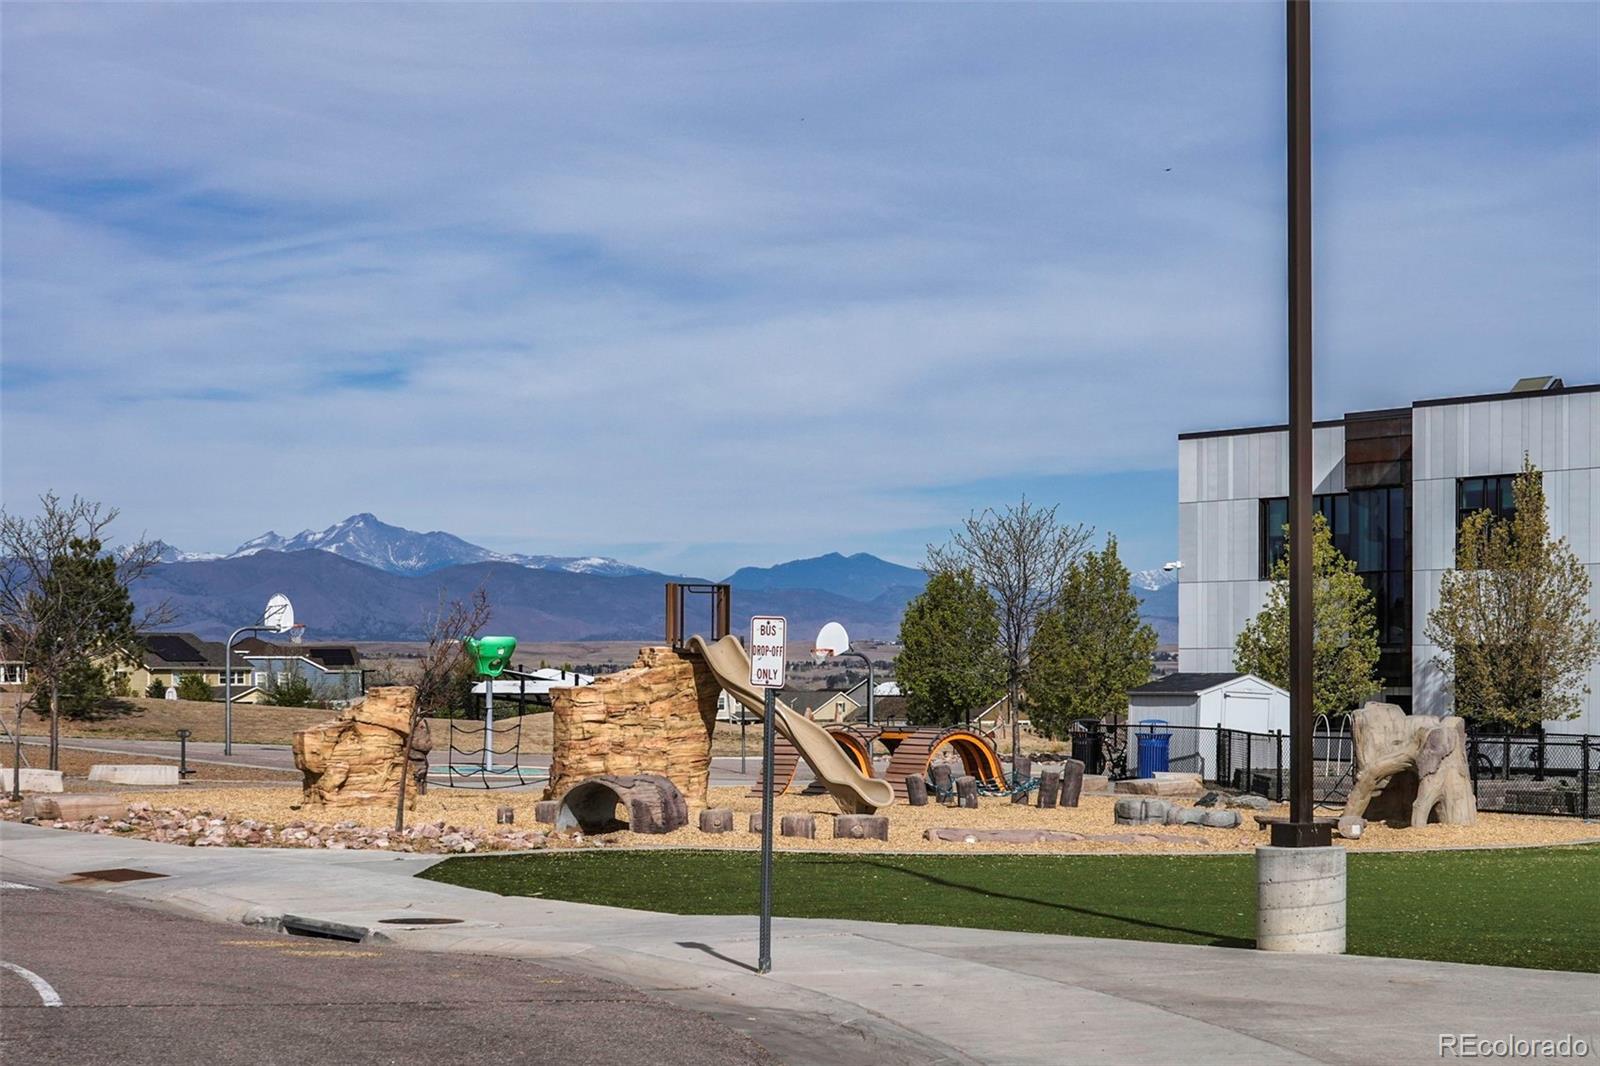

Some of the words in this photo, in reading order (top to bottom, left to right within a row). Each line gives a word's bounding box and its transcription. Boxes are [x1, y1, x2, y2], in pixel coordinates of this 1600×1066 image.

[760, 625, 777, 636] BUS
[752, 645, 783, 656] DROP-OFF
[757, 668, 778, 680] ONLY
